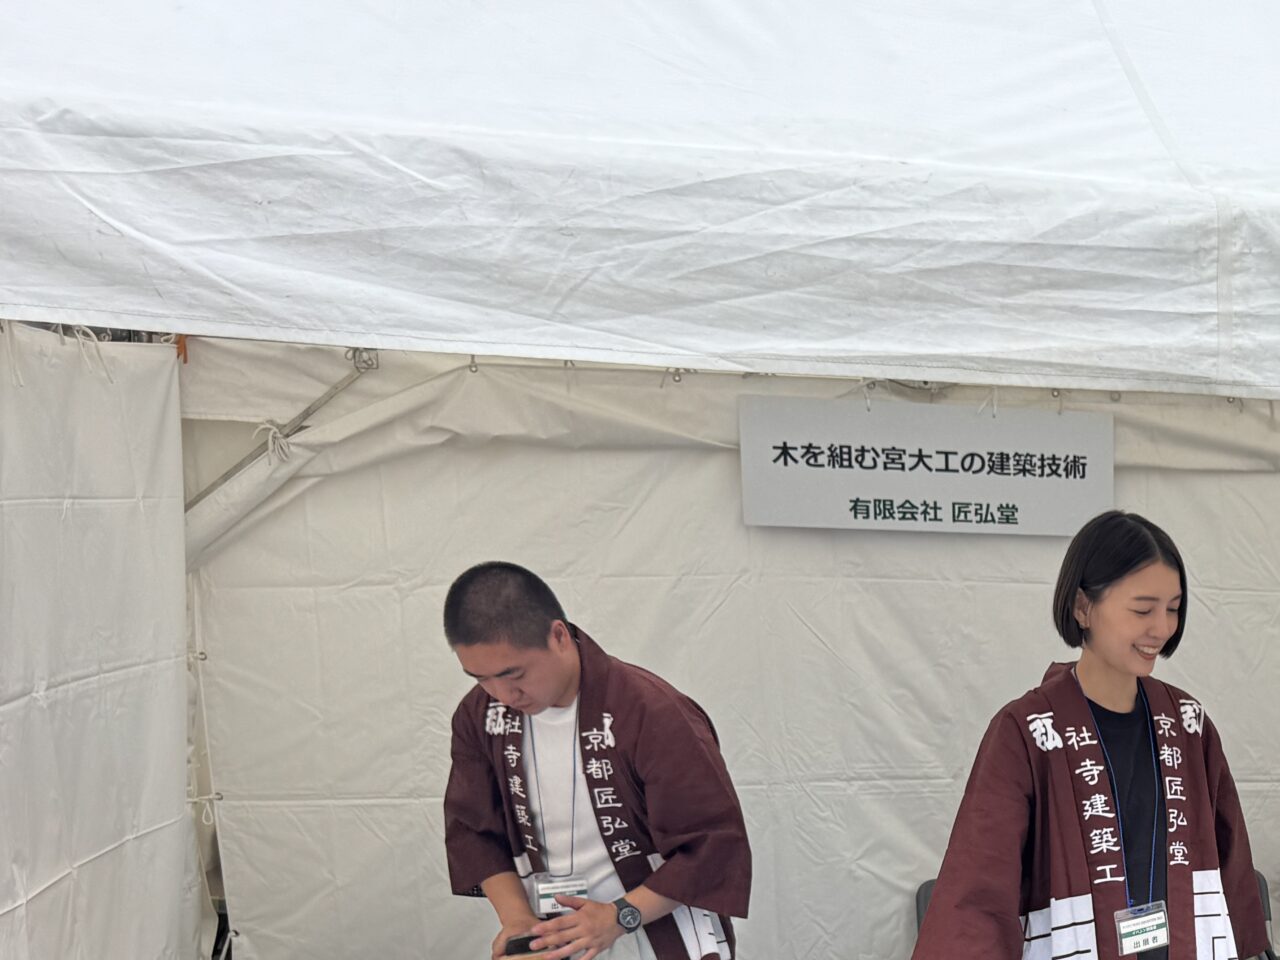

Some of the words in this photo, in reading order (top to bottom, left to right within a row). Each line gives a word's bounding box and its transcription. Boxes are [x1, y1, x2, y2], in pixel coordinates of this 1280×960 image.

[772, 441, 1088, 480] 木を組む宮大工の建築技術
[848, 497, 944, 524] 有限会社
[951, 501, 1020, 526] 匠弘堂
[581, 727, 642, 862] 京都匠弘堂
[1065, 725, 1126, 885] 社寺建築工
[1153, 712, 1190, 867] 京都匠弘堂
